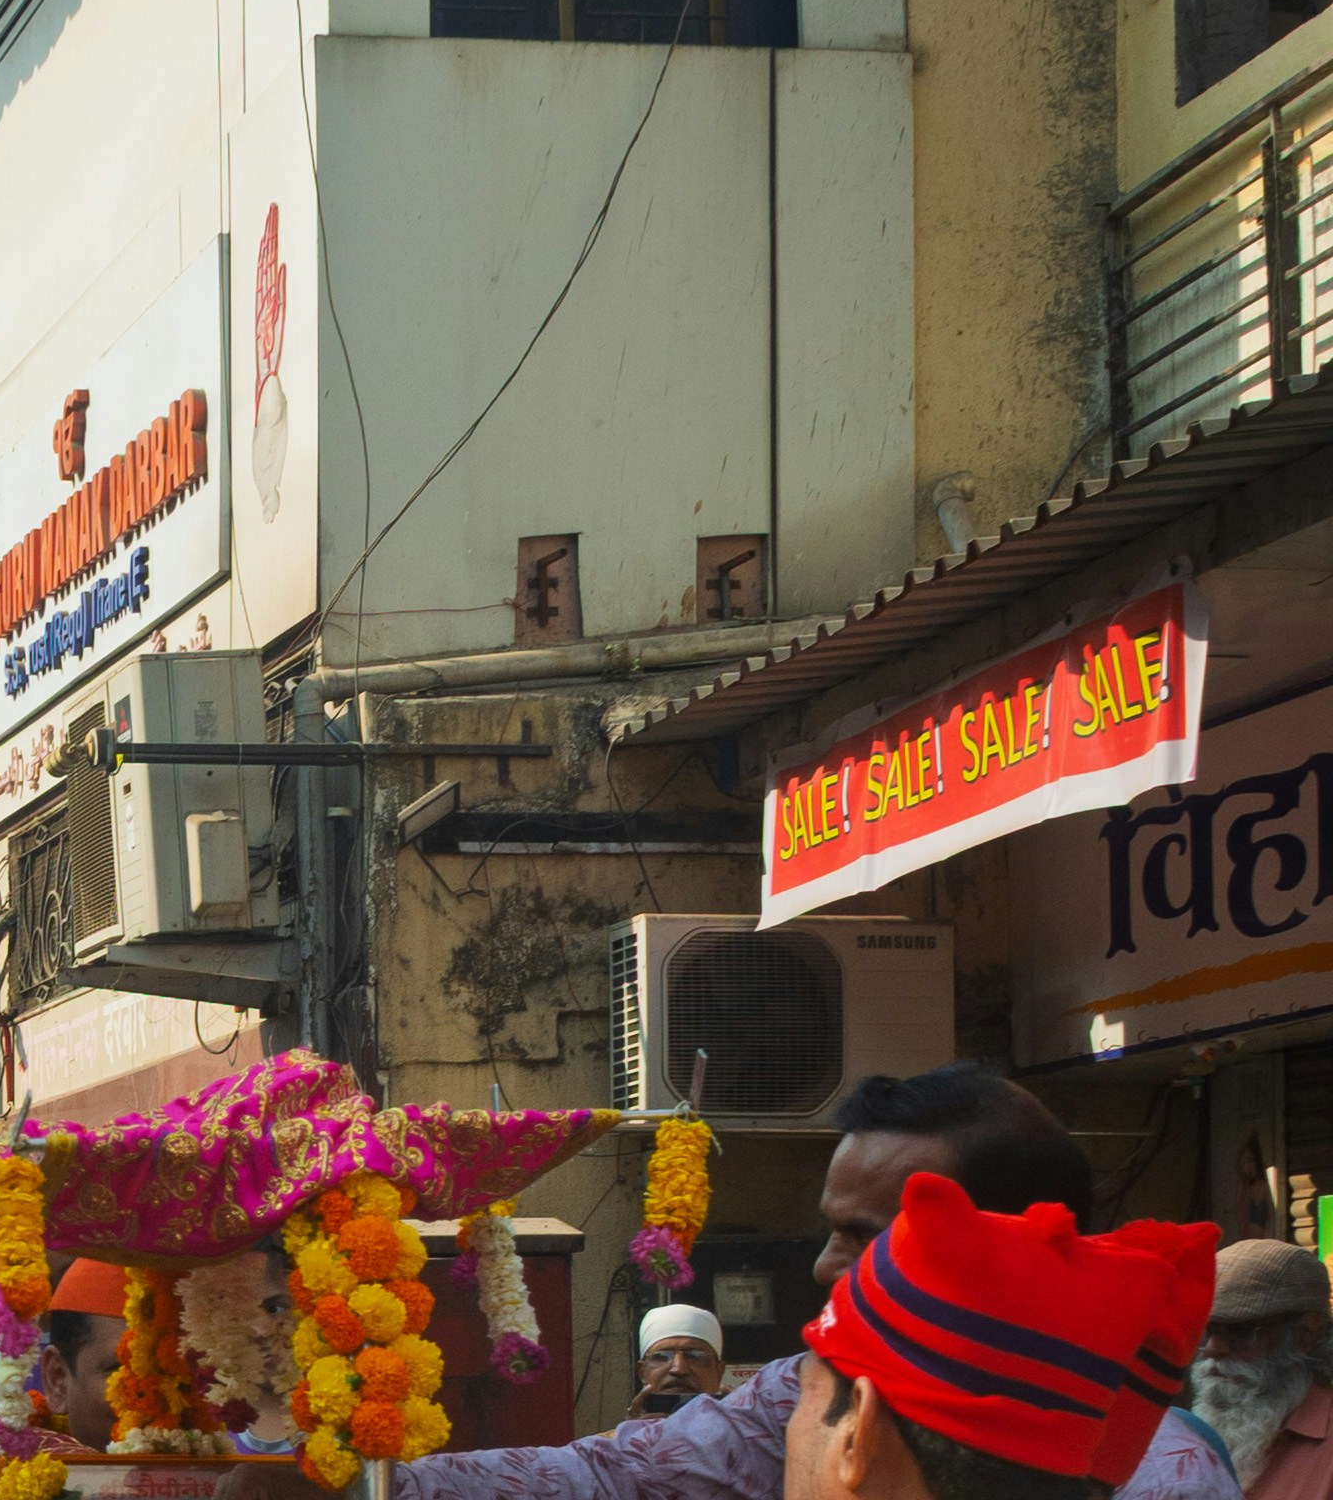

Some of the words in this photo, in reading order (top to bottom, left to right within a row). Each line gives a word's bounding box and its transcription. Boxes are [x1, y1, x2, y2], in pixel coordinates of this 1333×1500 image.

[39, 466, 110, 599] NANAK
[109, 388, 208, 543] DARBAR
[90, 577, 129, 628] Thane
[779, 763, 851, 862] SALE!
[863, 722, 945, 823] SALE!
[960, 681, 1053, 785] SALE!
[856, 935, 937, 949] SAMSUNG
